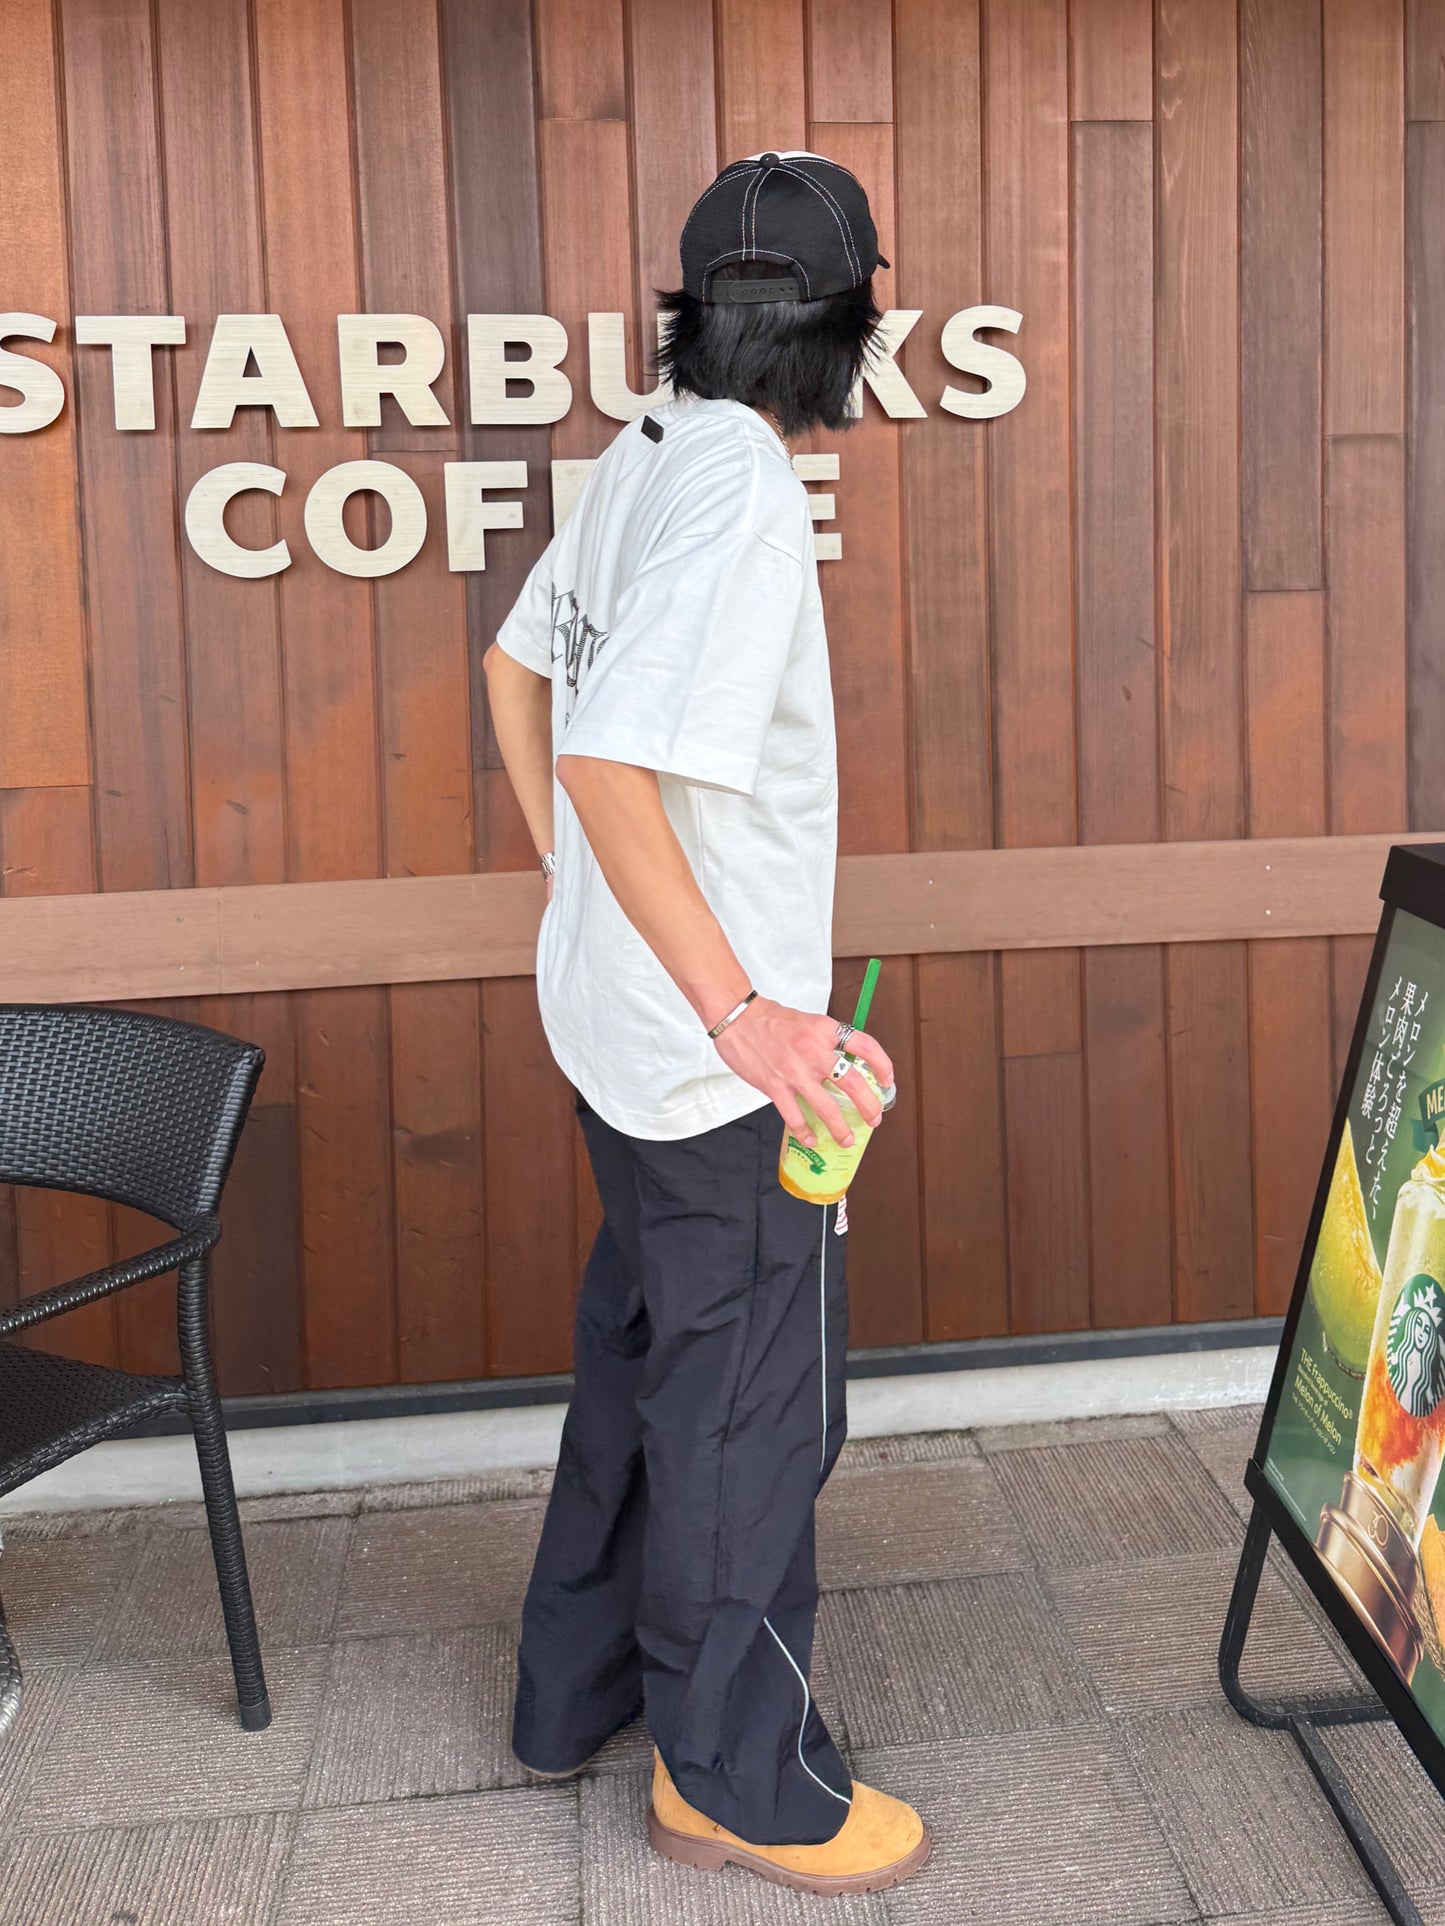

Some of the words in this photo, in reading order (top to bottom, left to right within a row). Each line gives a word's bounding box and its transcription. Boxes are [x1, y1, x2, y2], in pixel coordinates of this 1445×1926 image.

[0, 305, 1027, 433] STARBUKS
[1301, 1347, 1314, 1372] THE
[1294, 1374, 1314, 1408] Melon
[1313, 1403, 1322, 1418] of
[1320, 1409, 1342, 1446] Melon
